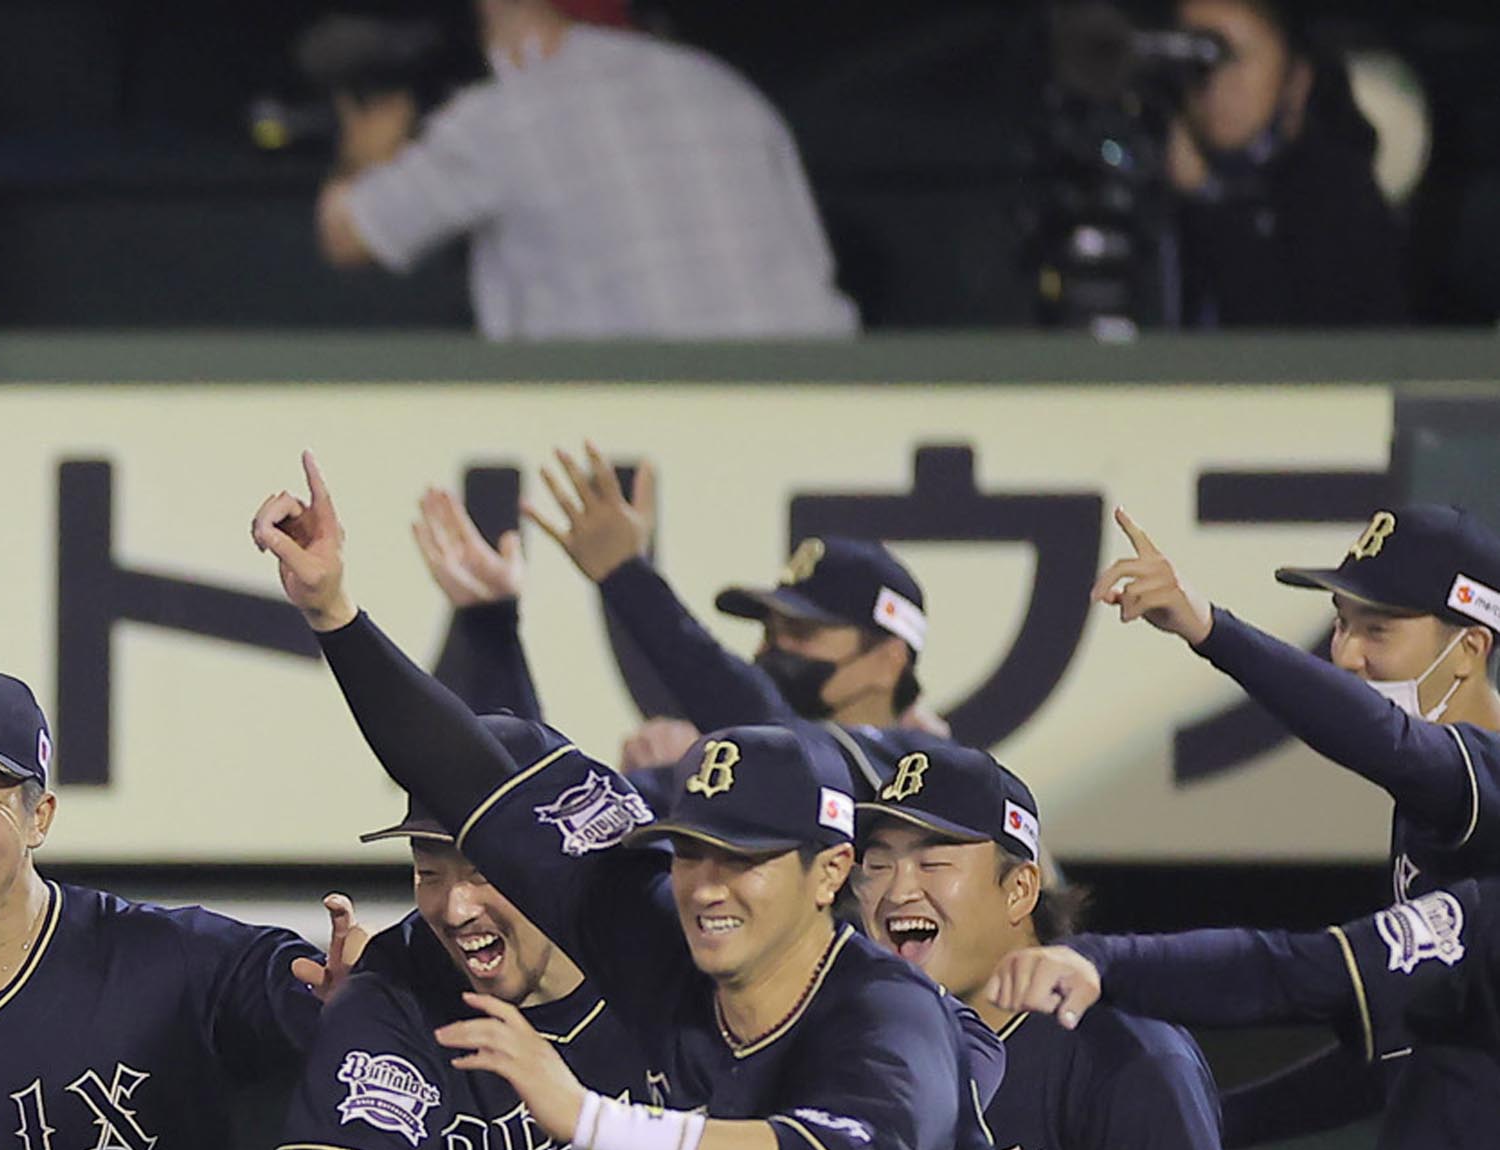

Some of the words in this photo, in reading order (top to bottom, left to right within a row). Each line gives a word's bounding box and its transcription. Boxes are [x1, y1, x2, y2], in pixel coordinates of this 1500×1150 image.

[1350, 511, 1396, 561] B
[686, 738, 741, 799] B
[882, 752, 930, 802] B
[338, 1050, 441, 1106] Buffaloes
